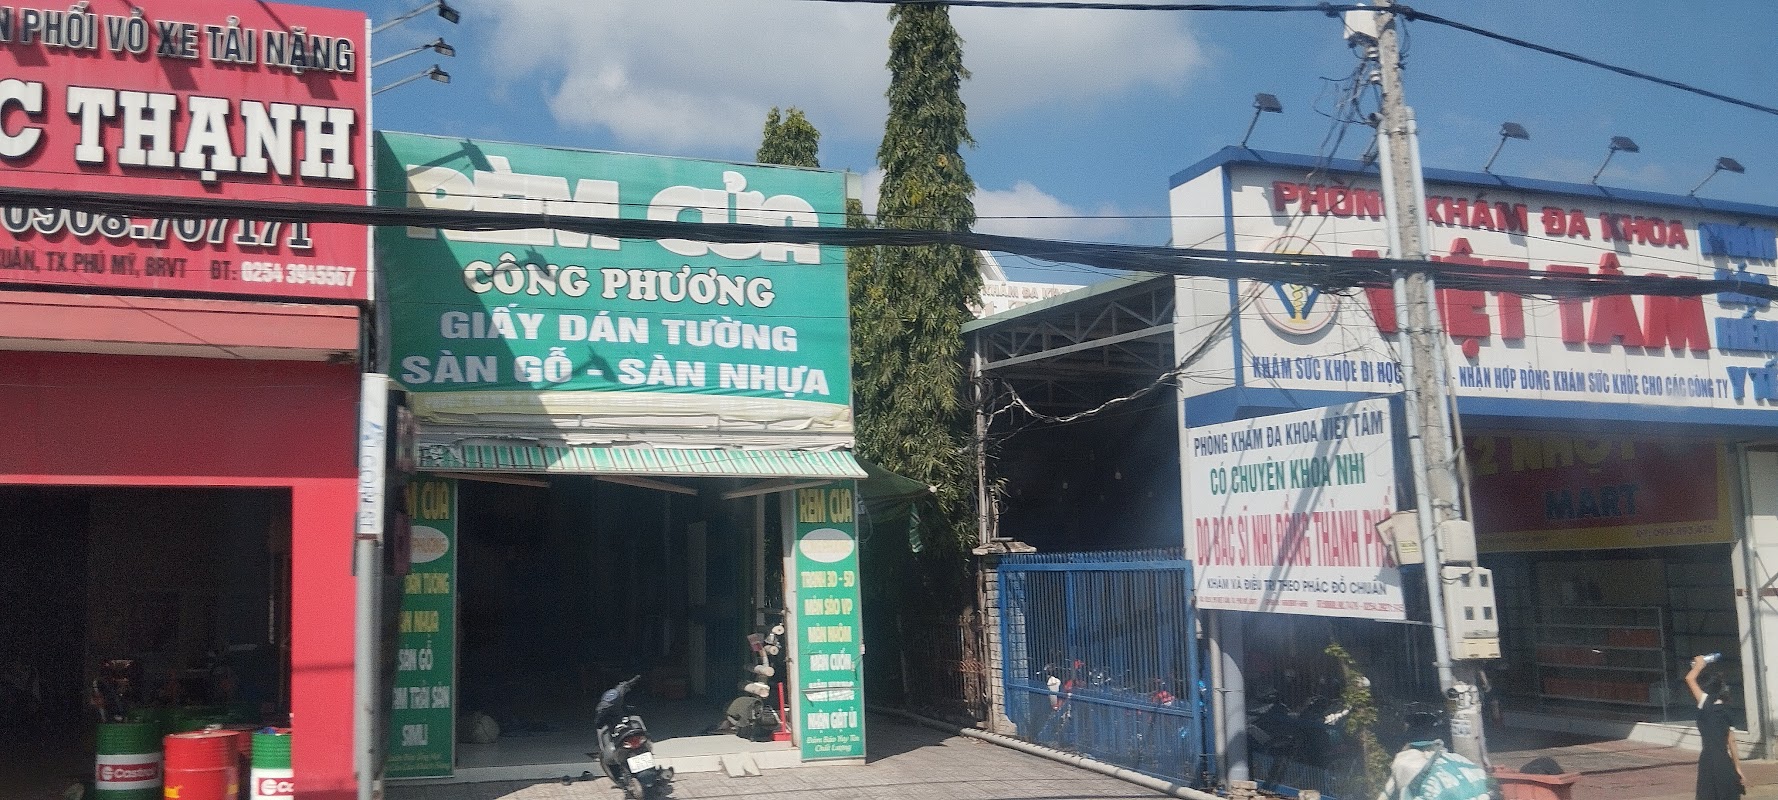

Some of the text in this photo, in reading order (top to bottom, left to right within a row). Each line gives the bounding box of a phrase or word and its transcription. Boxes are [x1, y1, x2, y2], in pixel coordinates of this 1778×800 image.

[20, 1, 98, 49] PHỐI
[105, 7, 149, 54] VỎ
[155, 19, 200, 59] XE
[206, 15, 256, 64] TẢI
[264, 26, 355, 73] NẶNG
[67, 85, 355, 183] THẠNH
[406, 155, 620, 251] RÈM
[1272, 180, 1388, 222] PHÒN
[1541, 206, 1591, 240] ĐA
[1599, 211, 1690, 249] KHOA
[47, 251, 67, 271] TX
[463, 252, 776, 308] CÔNG PHƯƠNG
[441, 303, 798, 352] GIẤY DÁN TƯỜNG
[1546, 252, 1711, 352] TÂM
[402, 347, 830, 399] SÀN GỖ - SÀN NHỰA
[1252, 353, 1292, 379] KHÁM
[1296, 354, 1321, 381] SỨC
[1360, 361, 1374, 383] ĐI
[1458, 365, 1492, 391] NHẬN
[1494, 364, 1517, 392] HỢP
[1519, 362, 1550, 392] ĐỒNG
[1552, 368, 1586, 392] KHÁM
[1588, 369, 1610, 394] SỨC
[1642, 374, 1663, 396] CHO
[1665, 371, 1686, 397] CÁC
[1688, 373, 1714, 398] CÔNG
[1716, 378, 1728, 398] TY
[1194, 407, 1384, 457] PHÒNG KHÁM ĐA KHOA VIỆT TÂM
[1210, 452, 1366, 496] CÓ CHUYÊN KHOA NHI
[1195, 517, 1210, 566] DO
[1213, 504, 1235, 566] BÁC
[1251, 514, 1273, 566] NHI
[1275, 493, 1312, 567] ĐỒNG
[1313, 498, 1361, 567] THÀNH
[1277, 579, 1300, 592] THEO
[1303, 577, 1328, 593] PHÁC
